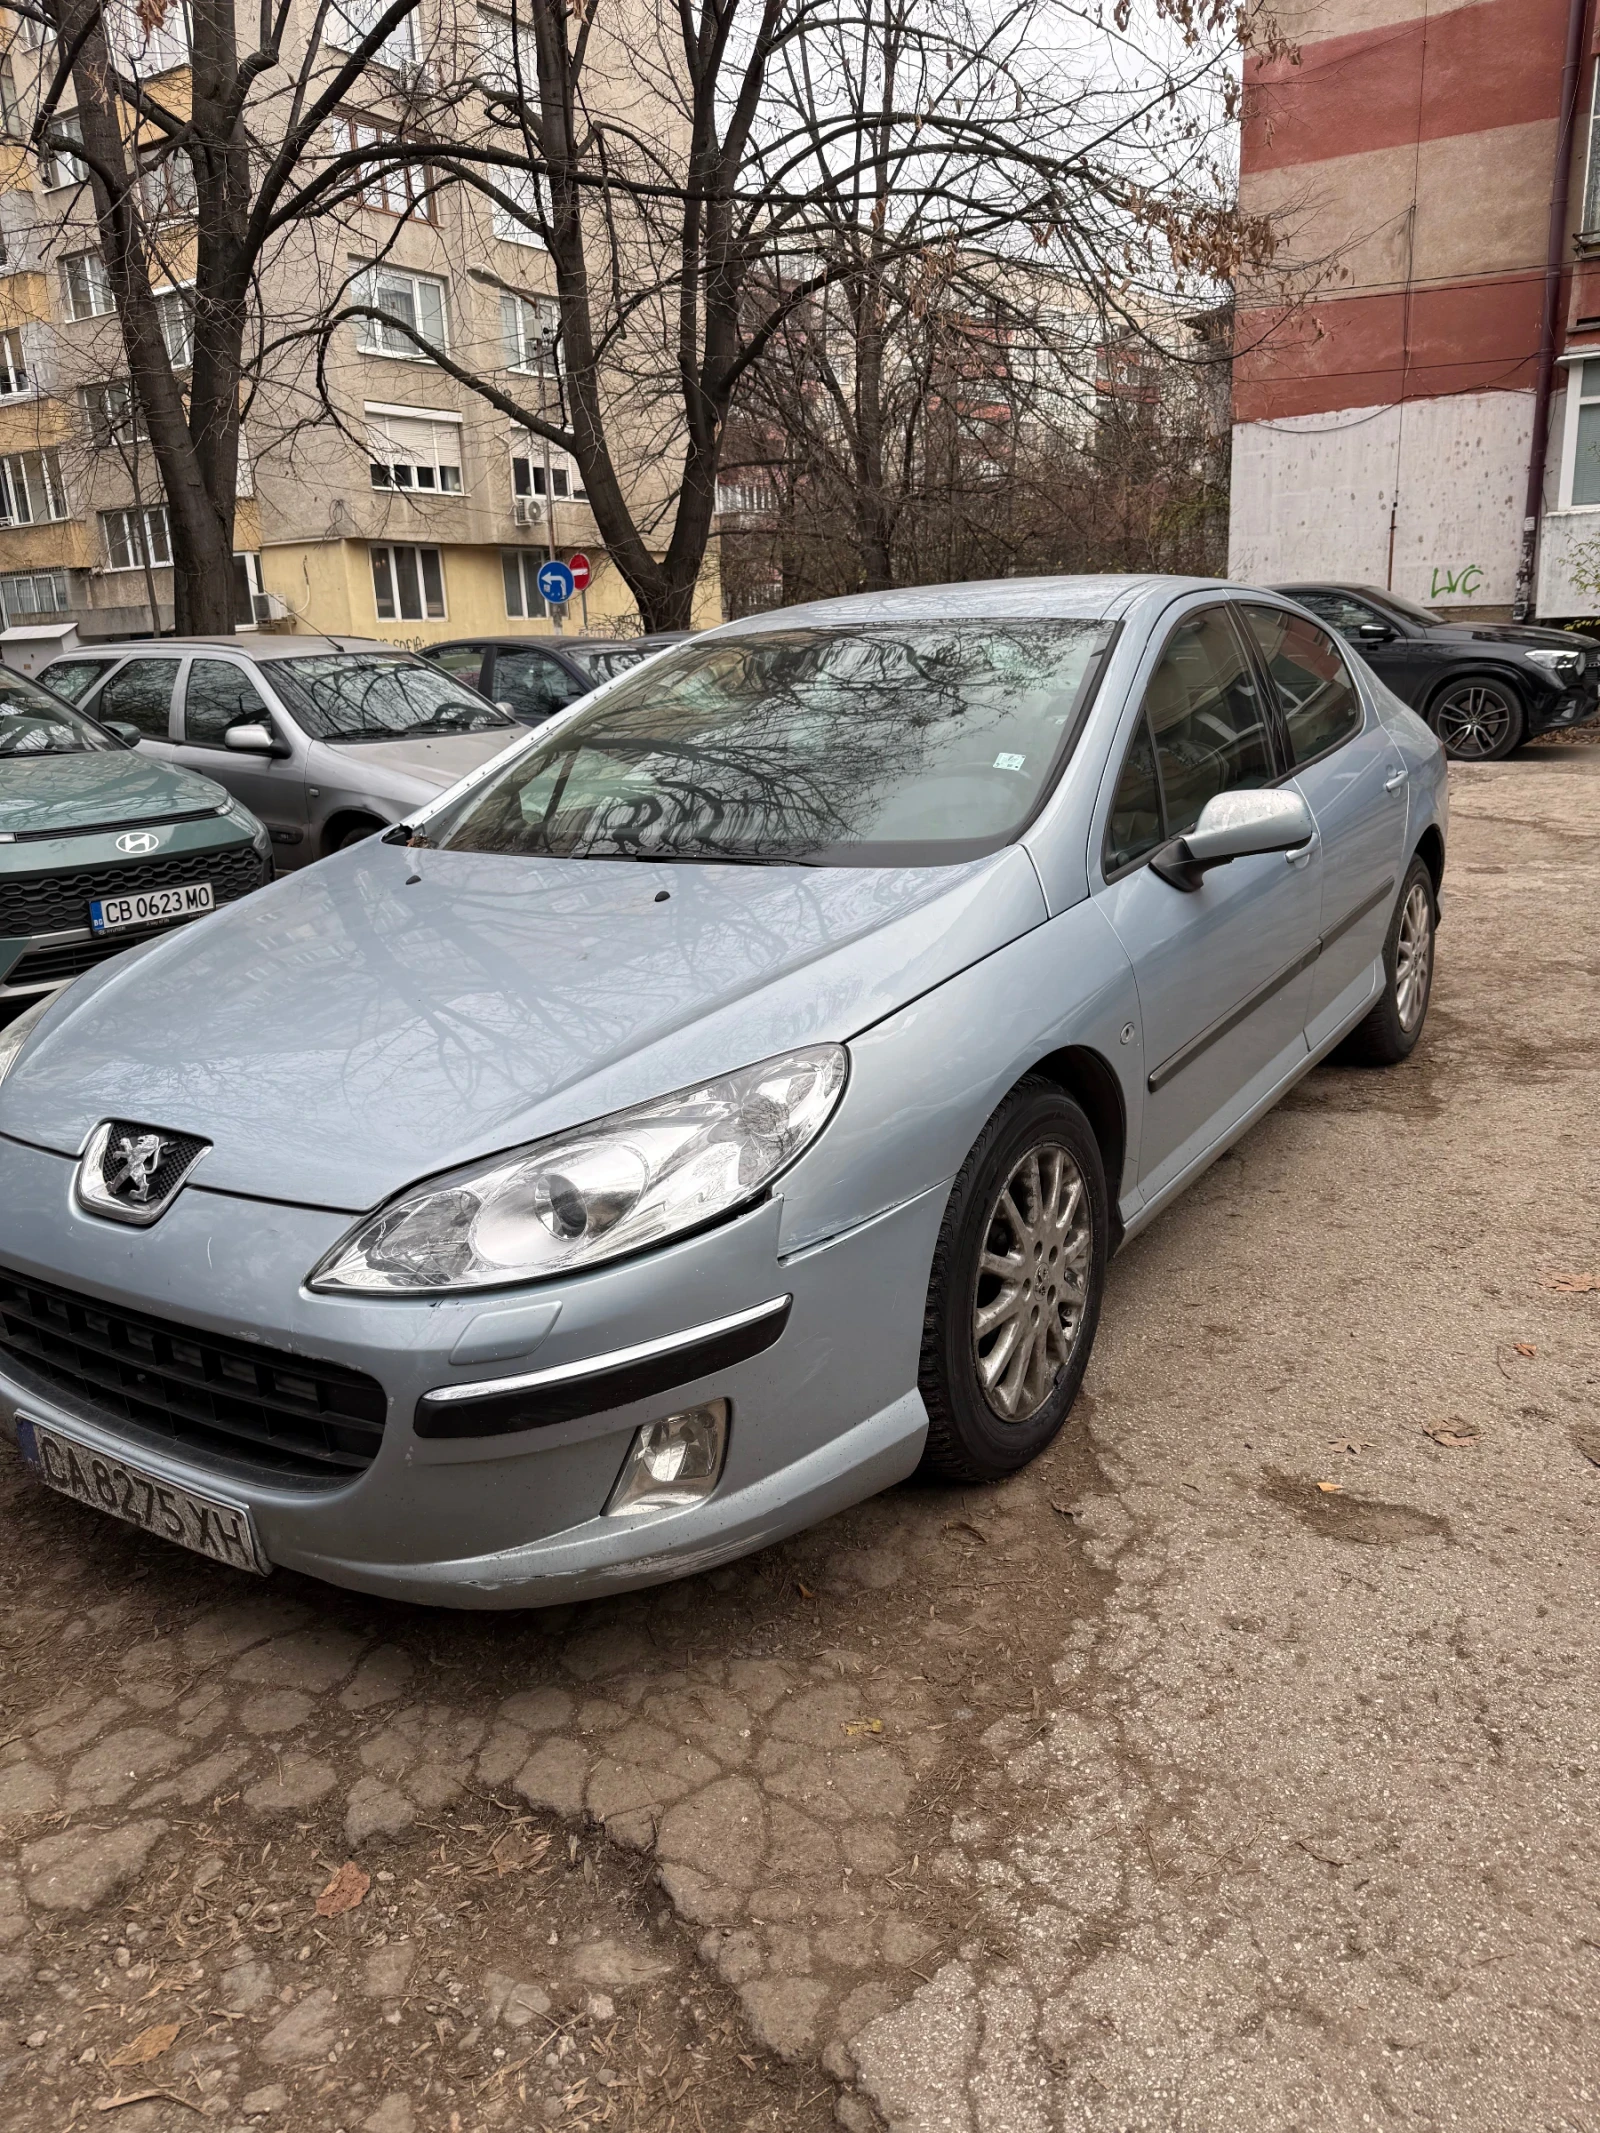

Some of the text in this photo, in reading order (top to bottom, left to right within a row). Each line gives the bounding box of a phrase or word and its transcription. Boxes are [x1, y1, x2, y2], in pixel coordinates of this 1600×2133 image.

[93, 918, 104, 927] BG
[105, 887, 210, 923] CB 0623 MO
[41, 1435, 92, 1501] CA
[92, 1459, 186, 1539] 8275
